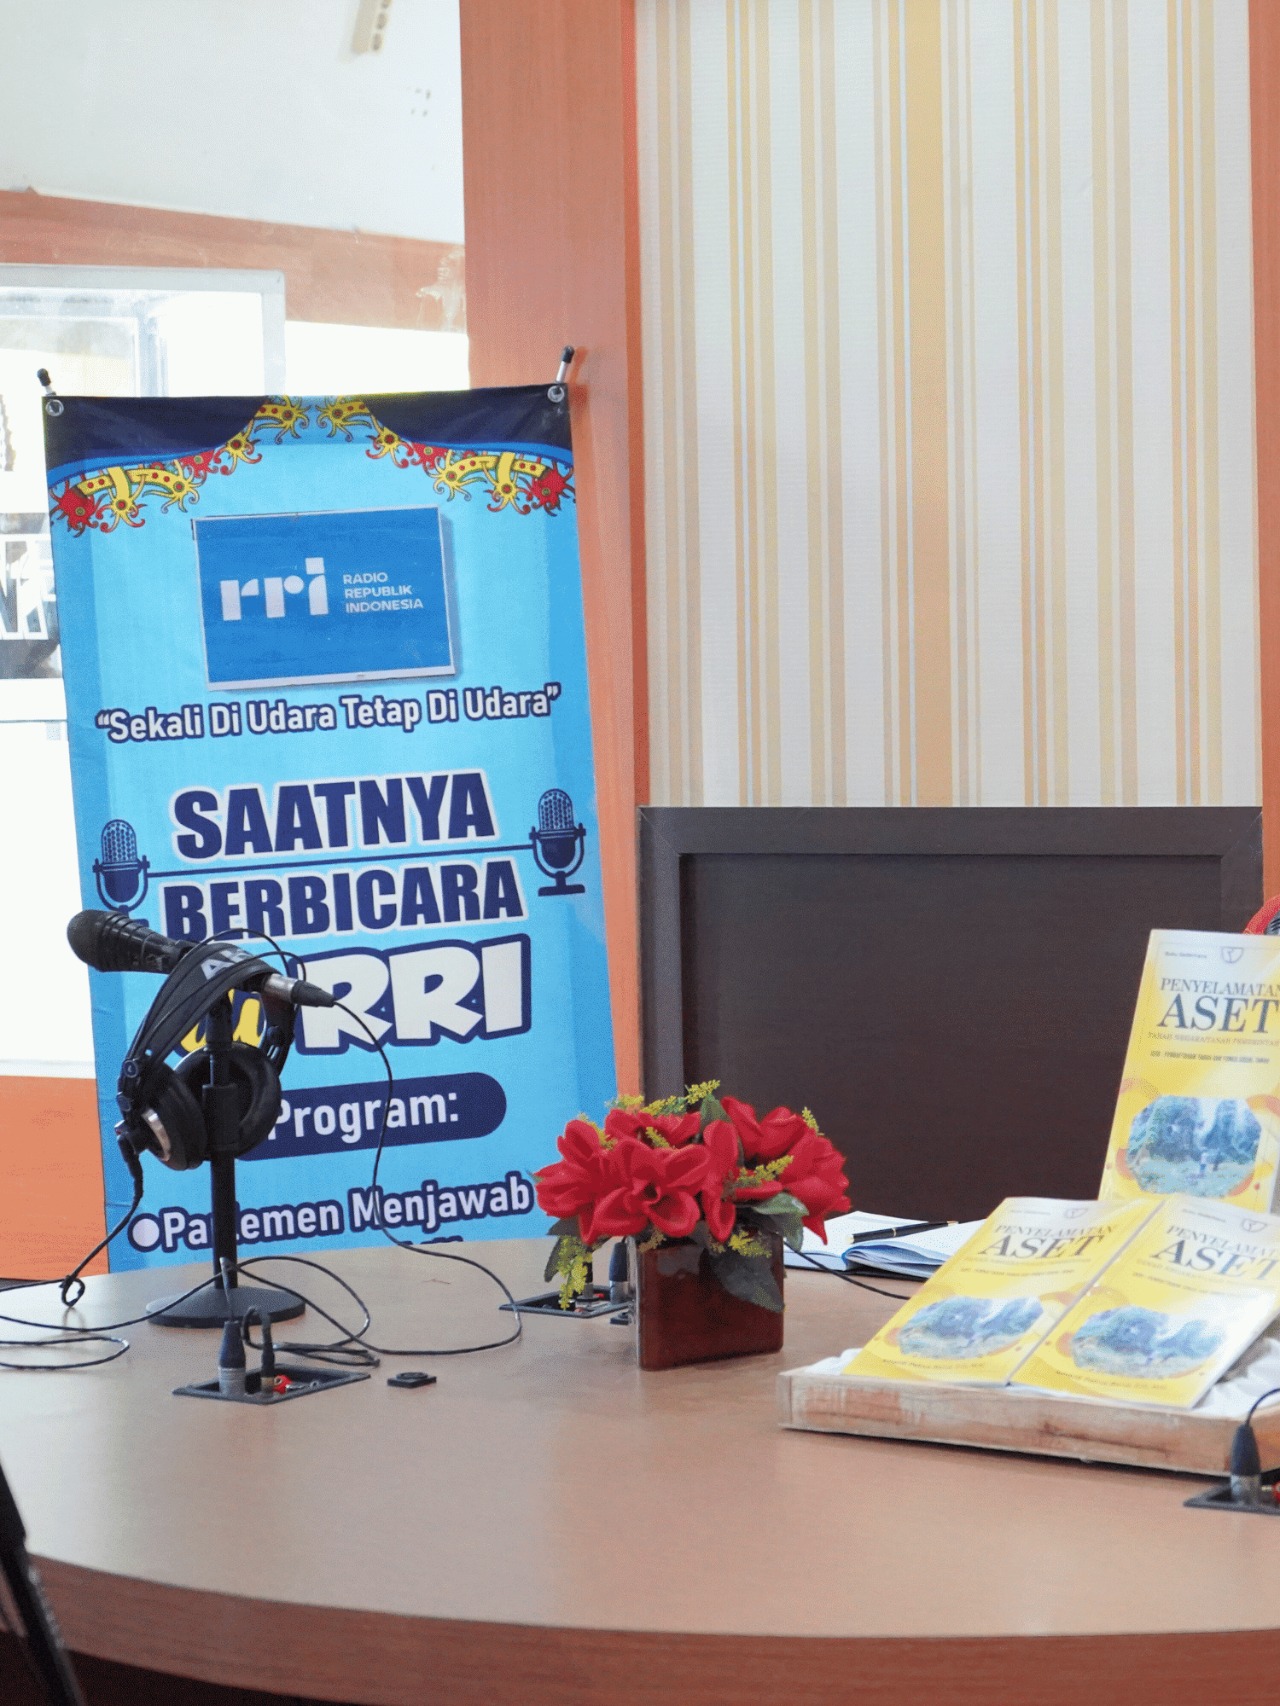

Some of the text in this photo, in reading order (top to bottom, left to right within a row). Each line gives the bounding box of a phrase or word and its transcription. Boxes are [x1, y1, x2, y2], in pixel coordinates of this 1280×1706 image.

[220, 557, 329, 621] rri
[343, 572, 388, 585] RADIO
[344, 585, 413, 599] REPUBLIK
[346, 598, 424, 614] INDONESIA
[212, 704, 240, 735] Di
[250, 702, 335, 731] Udara
[342, 696, 419, 731] Tetap
[429, 691, 457, 722] Di
[173, 772, 496, 859] SAATNYA
[163, 860, 524, 942] BERBICARA
[297, 942, 523, 1048] RRI
[1157, 993, 1280, 1034] ASET
[268, 1092, 459, 1143] Program:
[163, 1176, 530, 1248] Paemen Menjawab
[994, 1224, 1117, 1238] PENYELAMATAN
[978, 1234, 1106, 1259] ASET
